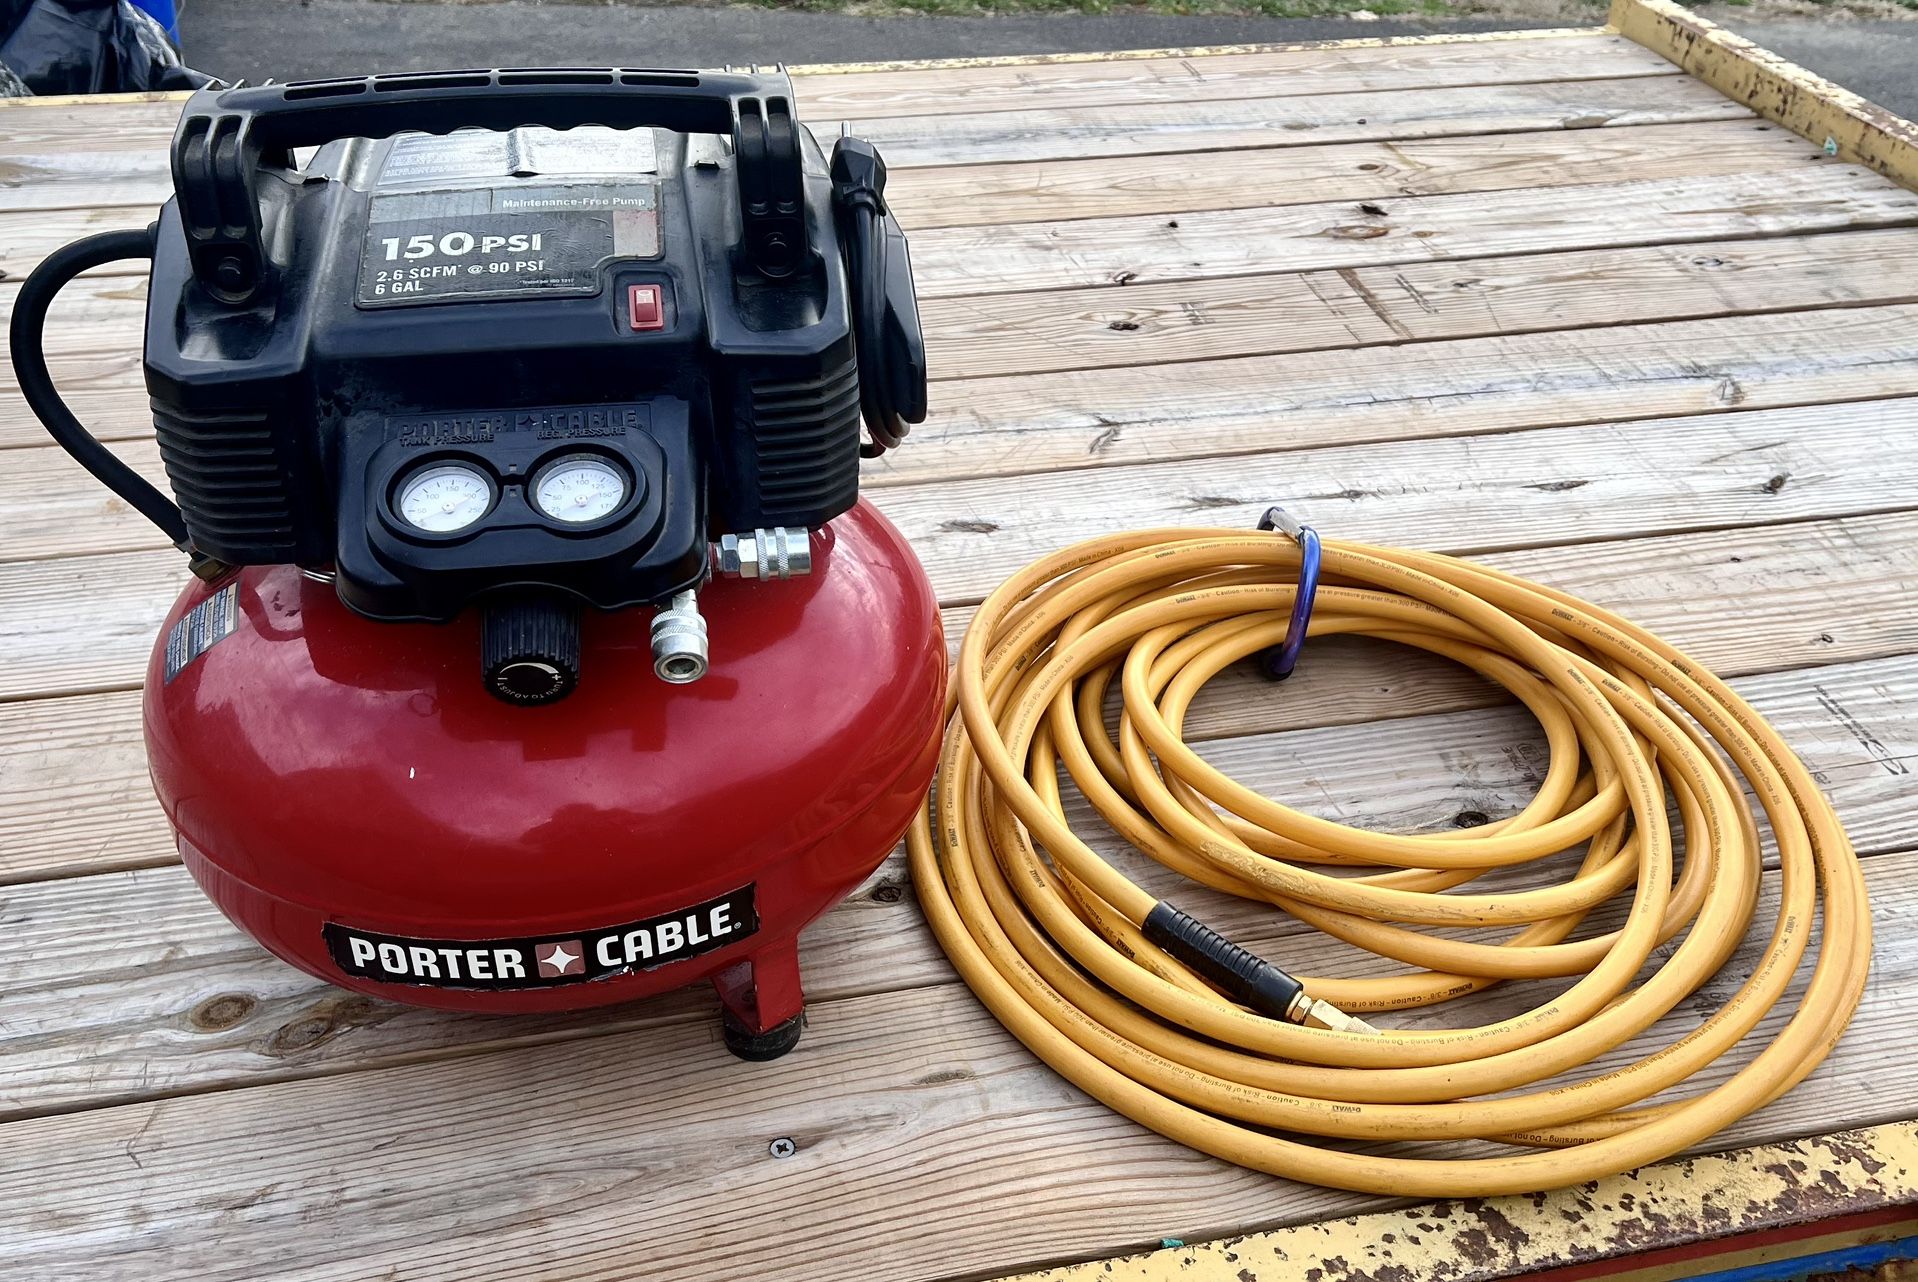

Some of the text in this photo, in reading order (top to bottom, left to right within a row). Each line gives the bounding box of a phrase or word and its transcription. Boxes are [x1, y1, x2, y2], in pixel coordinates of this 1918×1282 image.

[503, 197, 645, 208] Maintenance-Free Pump
[382, 231, 542, 261] 150 PSI
[376, 269, 403, 282] 2.6
[467, 265, 484, 274] @
[488, 262, 510, 273] 90
[515, 260, 544, 272] PSI
[375, 280, 424, 295] 6 GAL
[567, 426, 626, 438] PRESSURE
[400, 432, 495, 447] TANK PRESSURE
[1361, 593, 1383, 603] greater
[1592, 626, 1615, 641] Caution
[1619, 640, 1631, 651] Risk
[1637, 652, 1659, 669] Bursting
[497, 682, 529, 699] ADJUST
[348, 902, 732, 979] PORTER CABLE
[1046, 989, 1062, 1005] Made
[1391, 996, 1423, 1007] Caution
[1085, 1019, 1098, 1031] than
[1098, 1028, 1122, 1044] greater
[1478, 1025, 1511, 1039] Caution
[1390, 1037, 1404, 1046] Do
[1410, 1036, 1445, 1047] Bursting
[1456, 1034, 1474, 1043] Risk
[1121, 1042, 1151, 1059] pressure
[1158, 1060, 1171, 1069] use
[1171, 1063, 1184, 1074] not
[1183, 1070, 1195, 1080] Do
[1200, 1075, 1232, 1092] Bursting
[1243, 1088, 1261, 1099] Risk
[1266, 1094, 1300, 1107] Caution
[1514, 1132, 1529, 1141] not
[1549, 1134, 1585, 1145] Bursting
